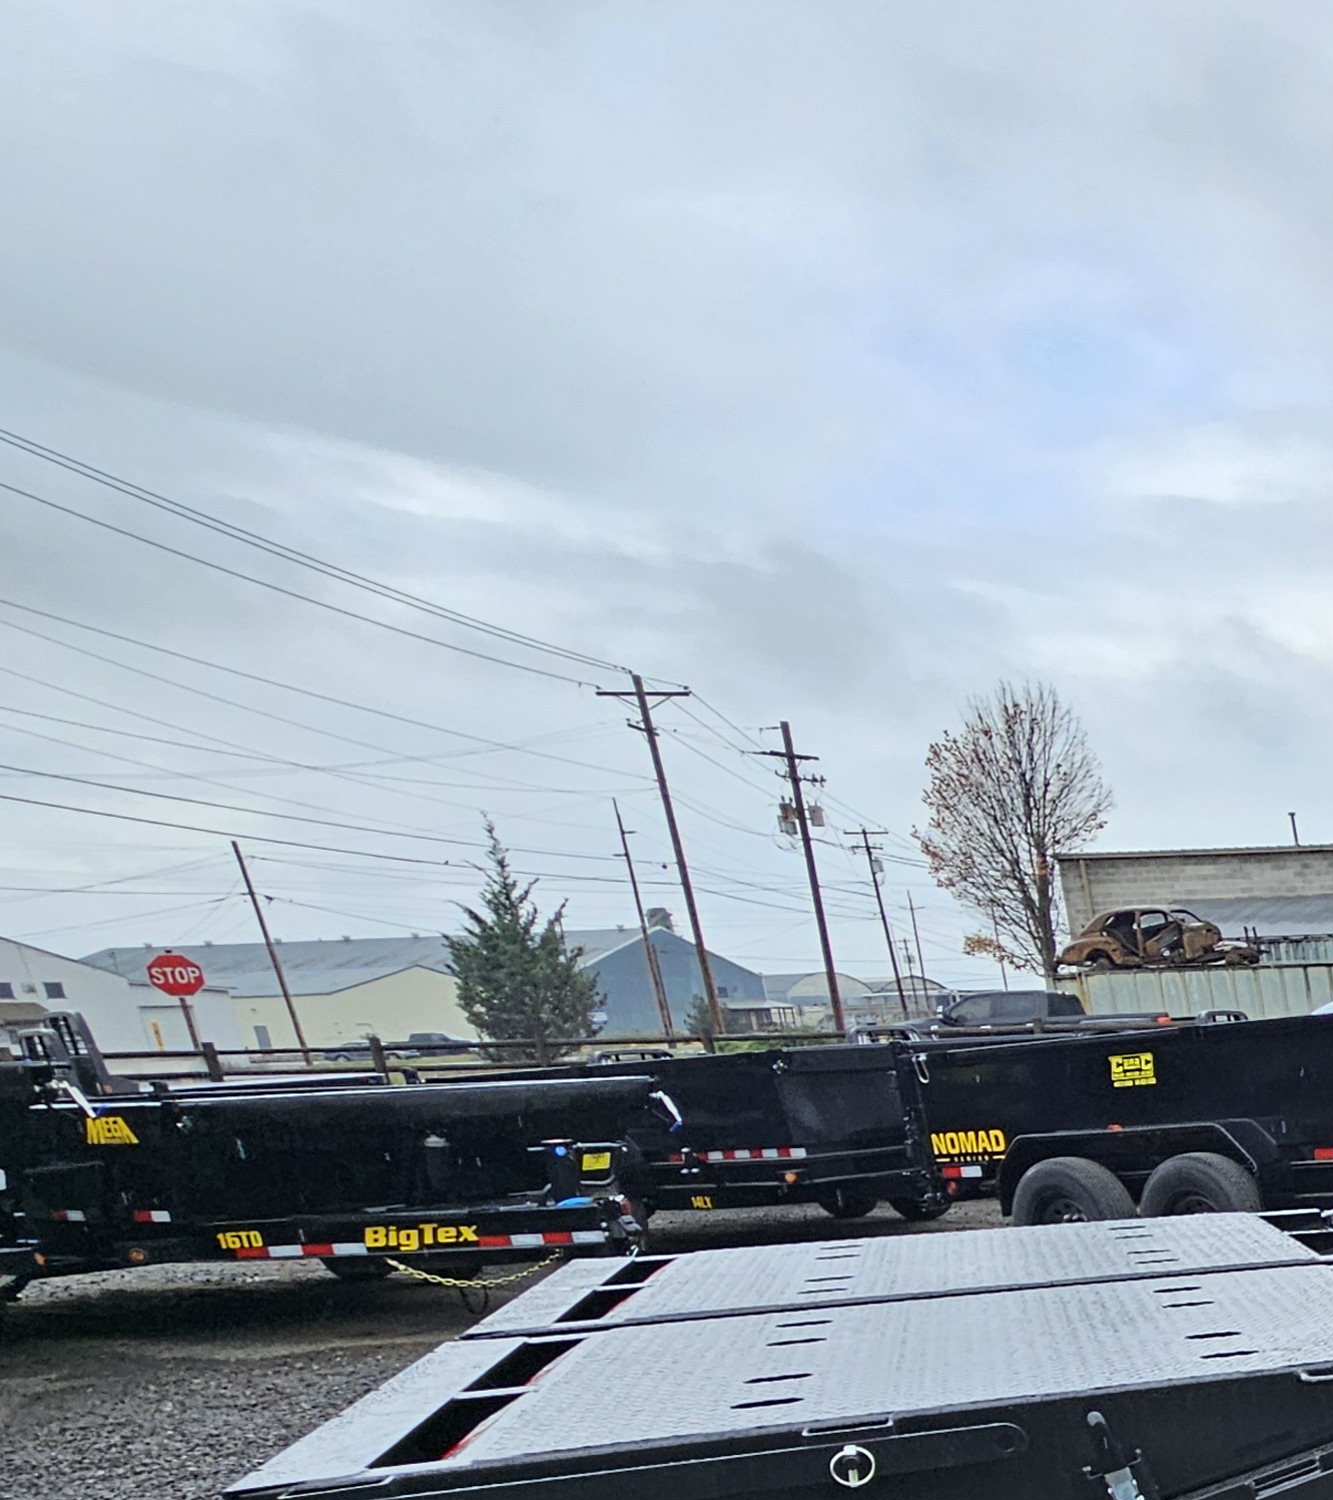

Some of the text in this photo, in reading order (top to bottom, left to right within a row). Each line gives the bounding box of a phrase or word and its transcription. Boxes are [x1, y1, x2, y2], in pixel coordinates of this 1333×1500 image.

[150, 966, 200, 984] STOP
[86, 1117, 139, 1144] MEGA
[930, 1129, 1006, 1155] NOMAD
[364, 1223, 479, 1251] BigTex
